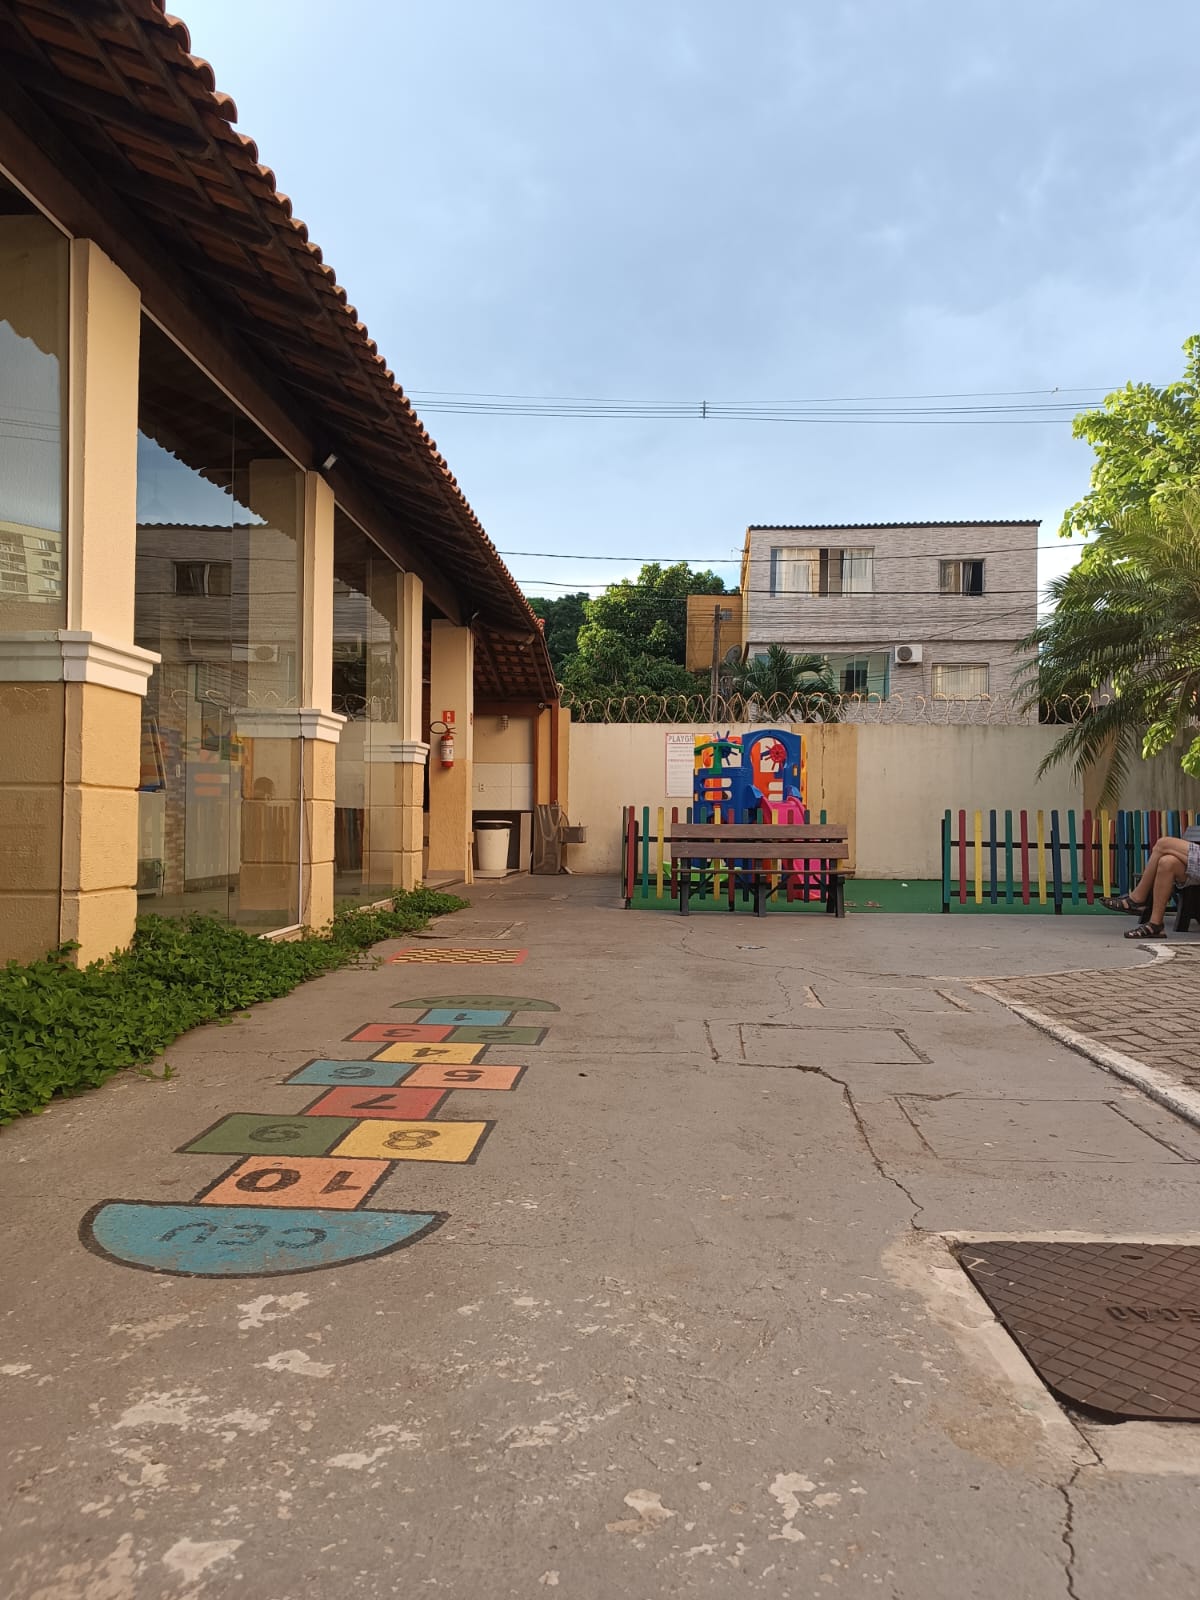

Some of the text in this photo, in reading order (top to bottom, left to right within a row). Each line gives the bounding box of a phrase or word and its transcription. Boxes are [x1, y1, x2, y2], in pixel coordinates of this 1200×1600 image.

[453, 1013, 474, 1022] 1
[382, 1029, 422, 1038] 3
[476, 1031, 516, 1040] 2
[410, 1048, 451, 1058] 4
[329, 1066, 376, 1080] 6
[442, 1070, 485, 1082] 5
[351, 1094, 398, 1109] 7
[248, 1124, 309, 1143] 9
[383, 1129, 441, 1150] 8
[235, 1169, 361, 1194] 10
[159, 1223, 327, 1249] CEU
